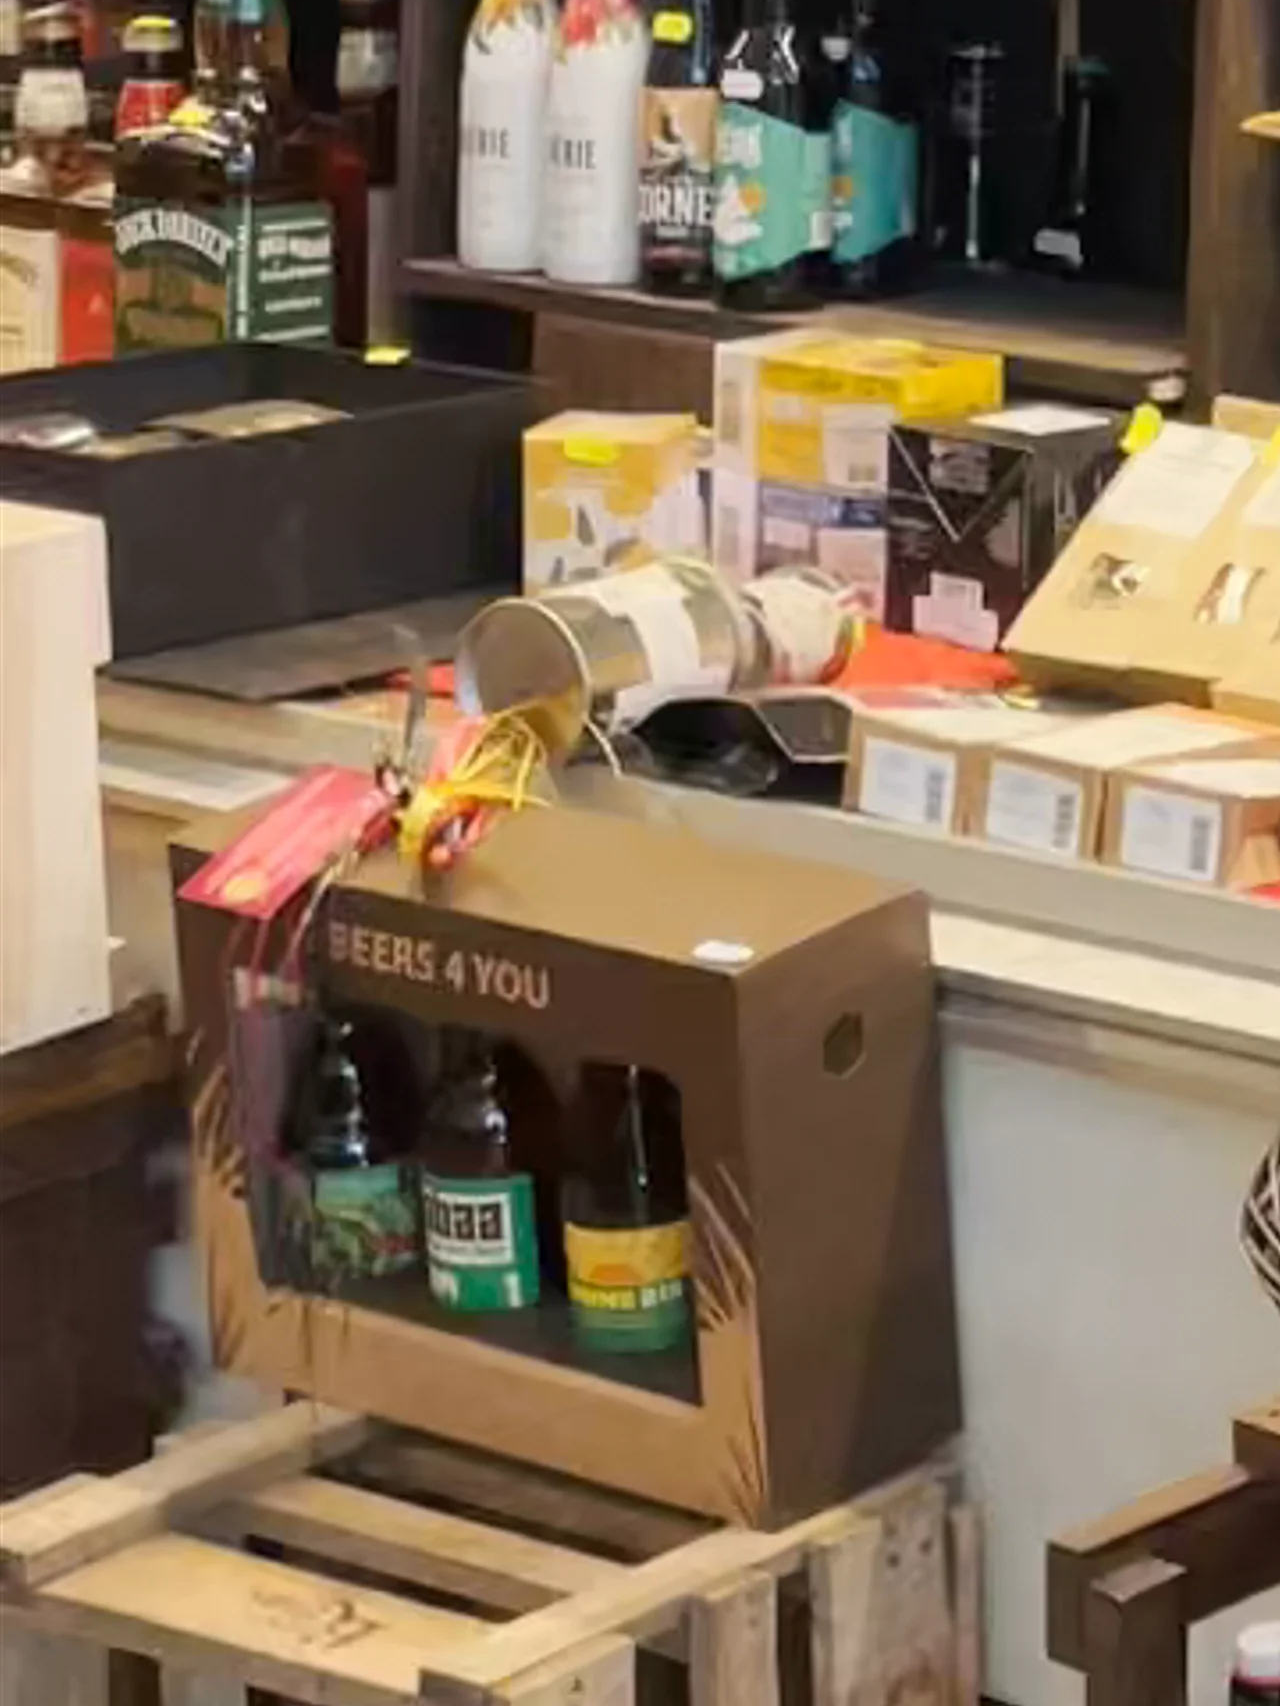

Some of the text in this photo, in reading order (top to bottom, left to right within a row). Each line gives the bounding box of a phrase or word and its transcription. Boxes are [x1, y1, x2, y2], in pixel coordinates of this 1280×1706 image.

[328, 920, 550, 1010] BEERS 4 YOU
